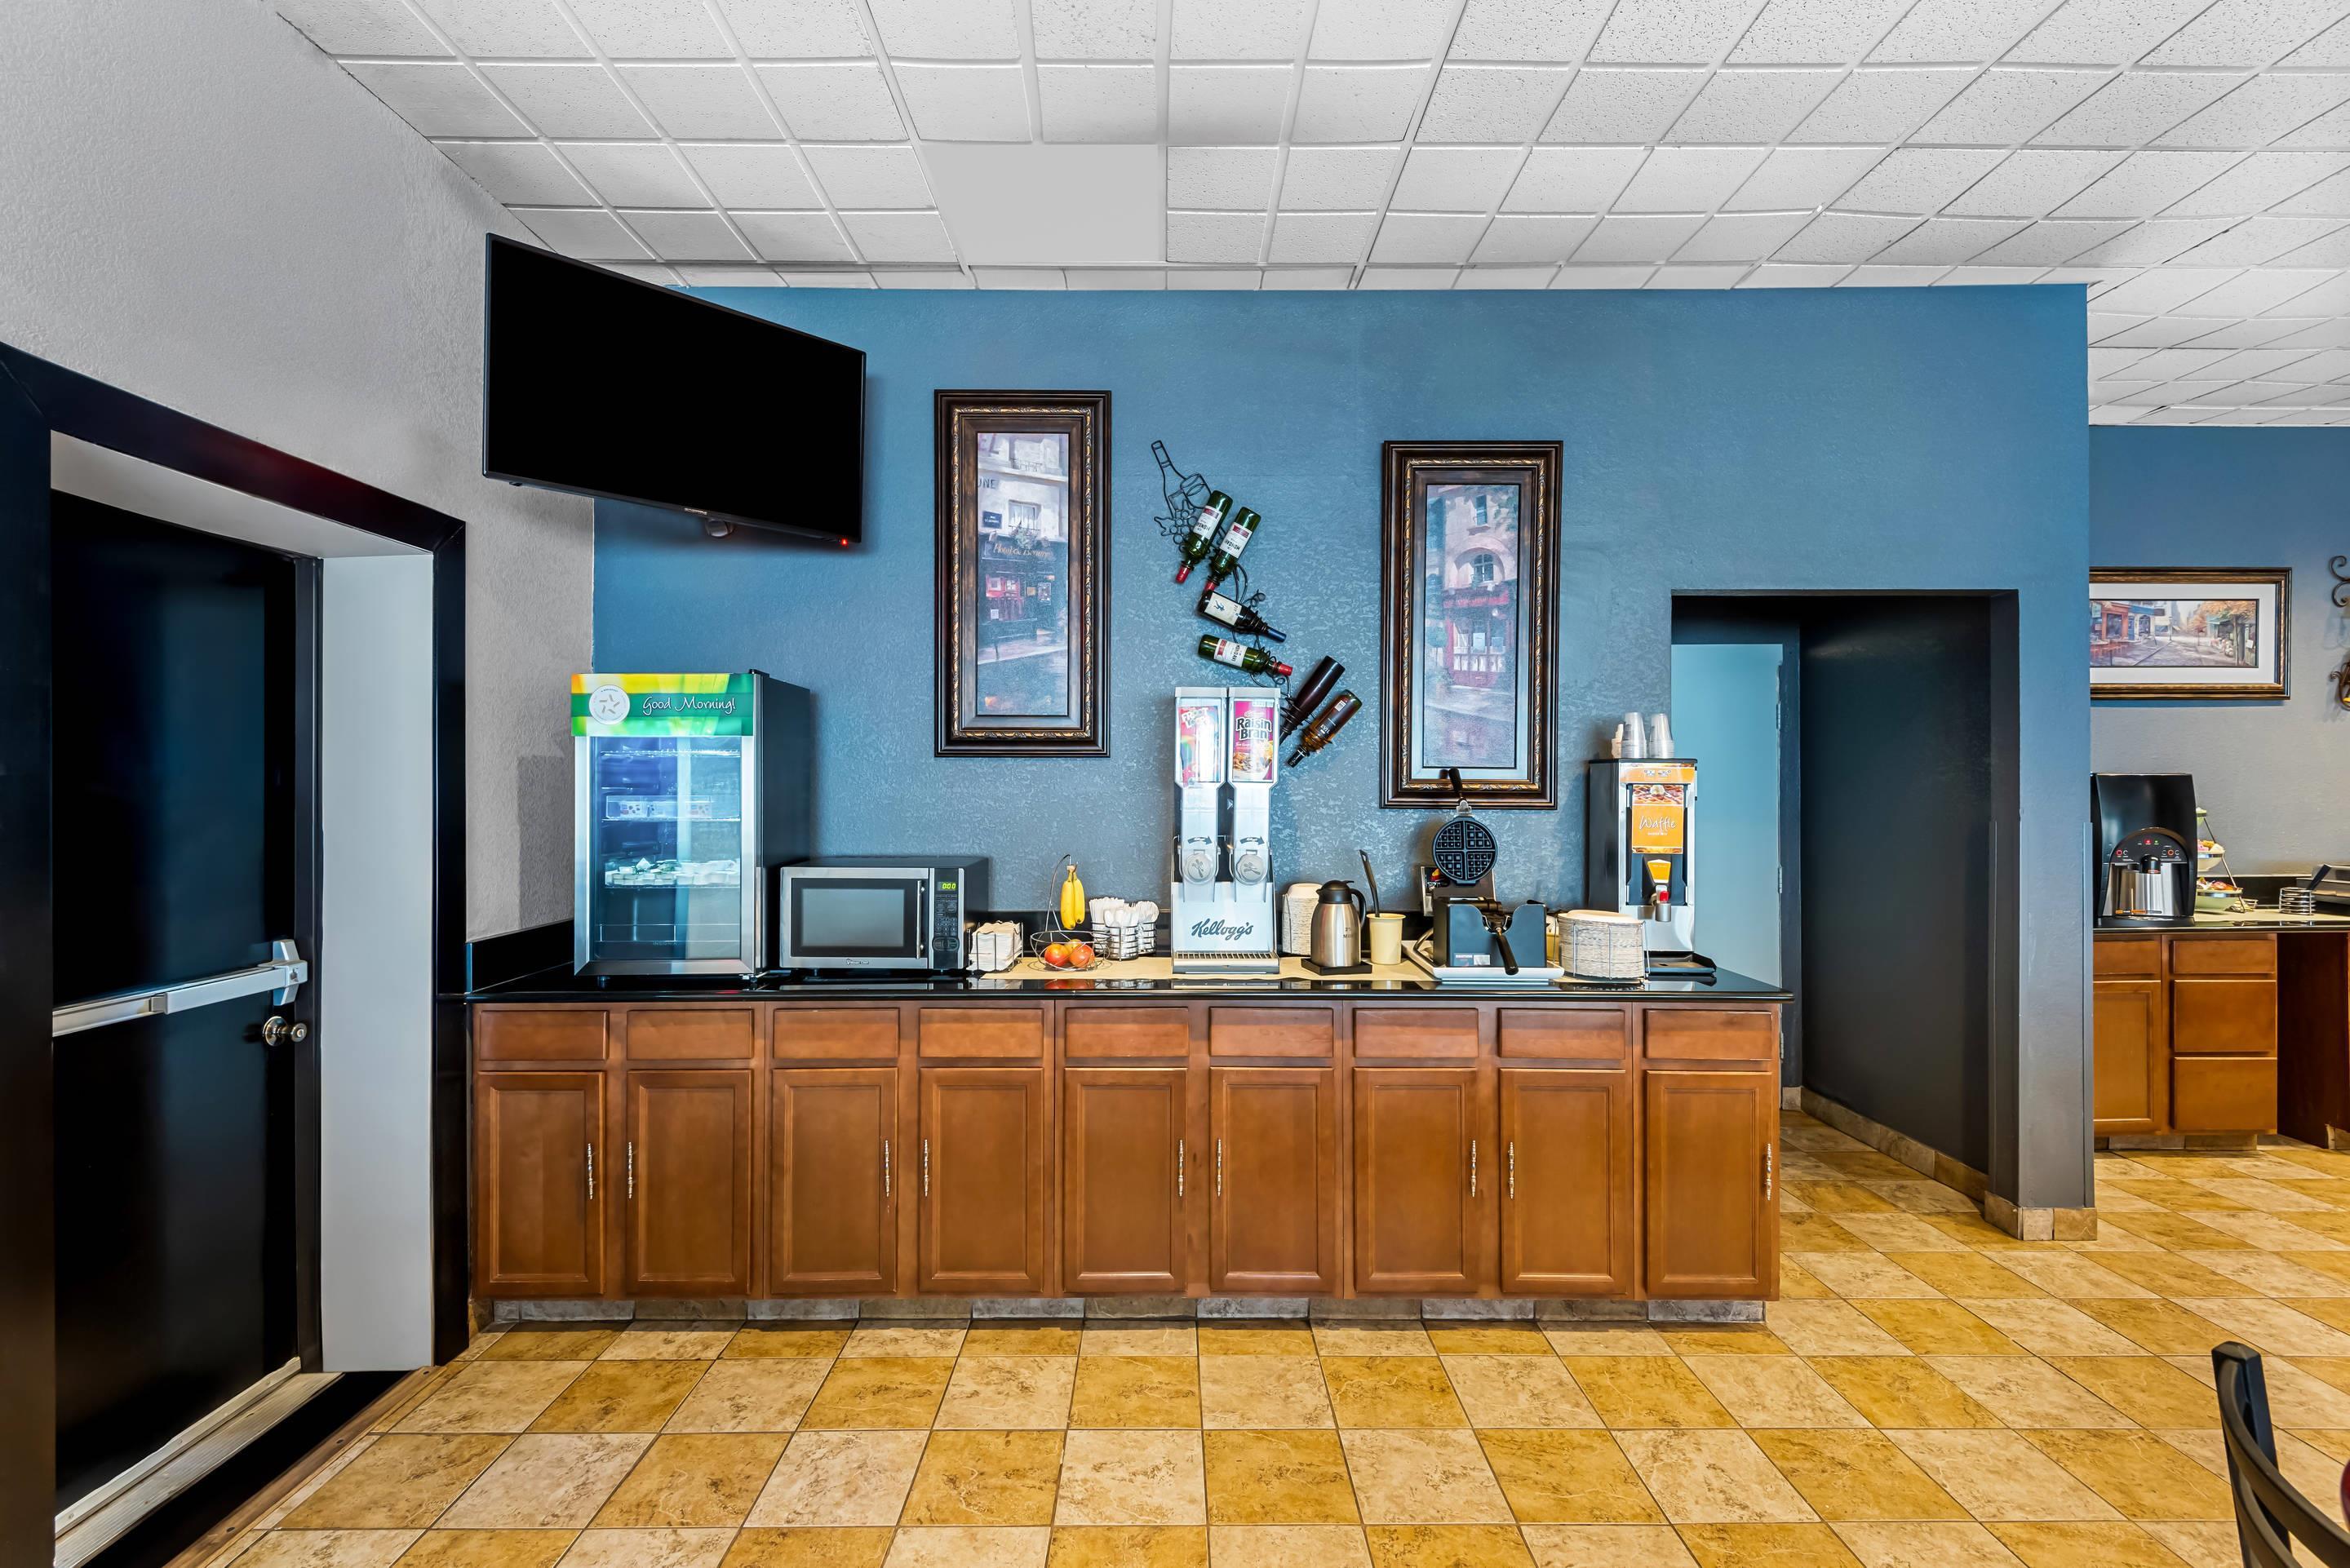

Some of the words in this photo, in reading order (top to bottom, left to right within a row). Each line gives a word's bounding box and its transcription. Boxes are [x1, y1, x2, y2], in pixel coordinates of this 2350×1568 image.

[642, 696, 672, 716] Good
[674, 696, 737, 715] Morning!
[1236, 717, 1272, 732] Raisin
[1240, 729, 1268, 740] Bran
[1638, 815, 1677, 832] Waffle
[1191, 918, 1254, 941] Kellogg's
